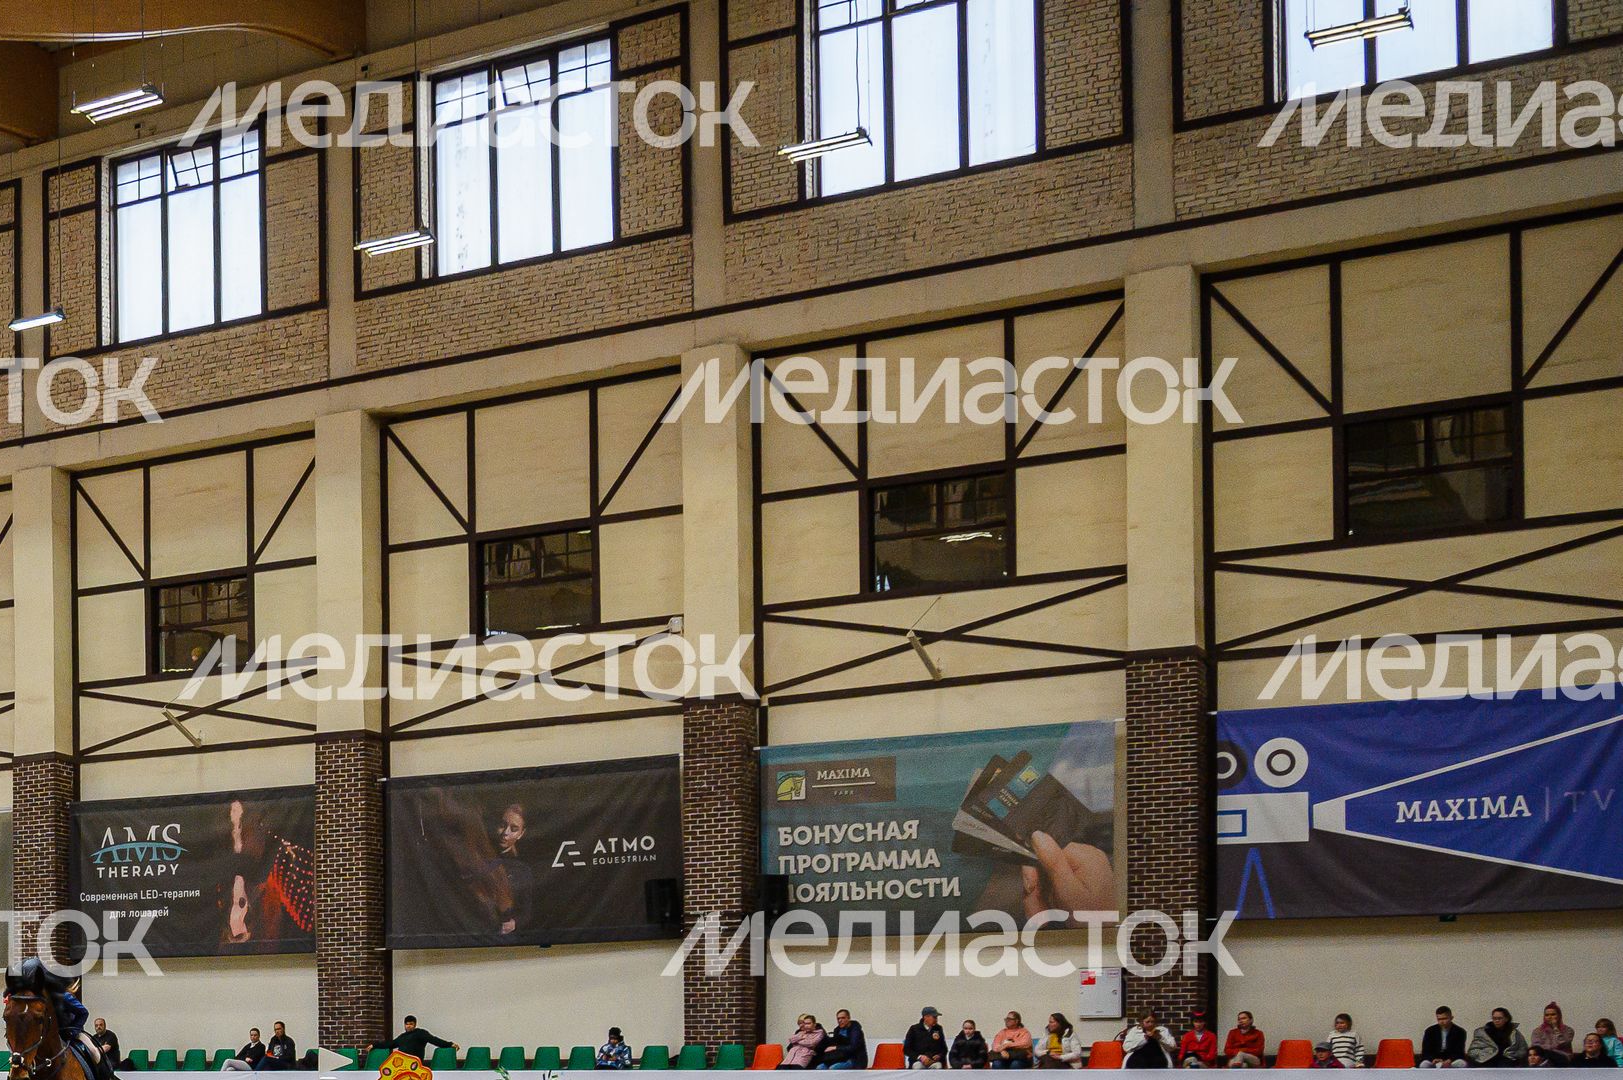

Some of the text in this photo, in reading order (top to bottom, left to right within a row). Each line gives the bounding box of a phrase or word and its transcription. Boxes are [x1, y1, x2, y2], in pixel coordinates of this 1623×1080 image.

[816, 767, 871, 781] MAXIMA
[1395, 794, 1532, 823] MAXIMA
[778, 819, 919, 846] БОНУСНАЯ
[93, 823, 182, 863] AMS
[593, 835, 655, 854] ATMO
[592, 854, 657, 865] EQUESTRIAN
[778, 848, 941, 875] ПРОГРАММА
[96, 863, 180, 878] THERAPY
[79, 889, 201, 903] Современная LED-терапия
[109, 906, 169, 919] для лошадей
